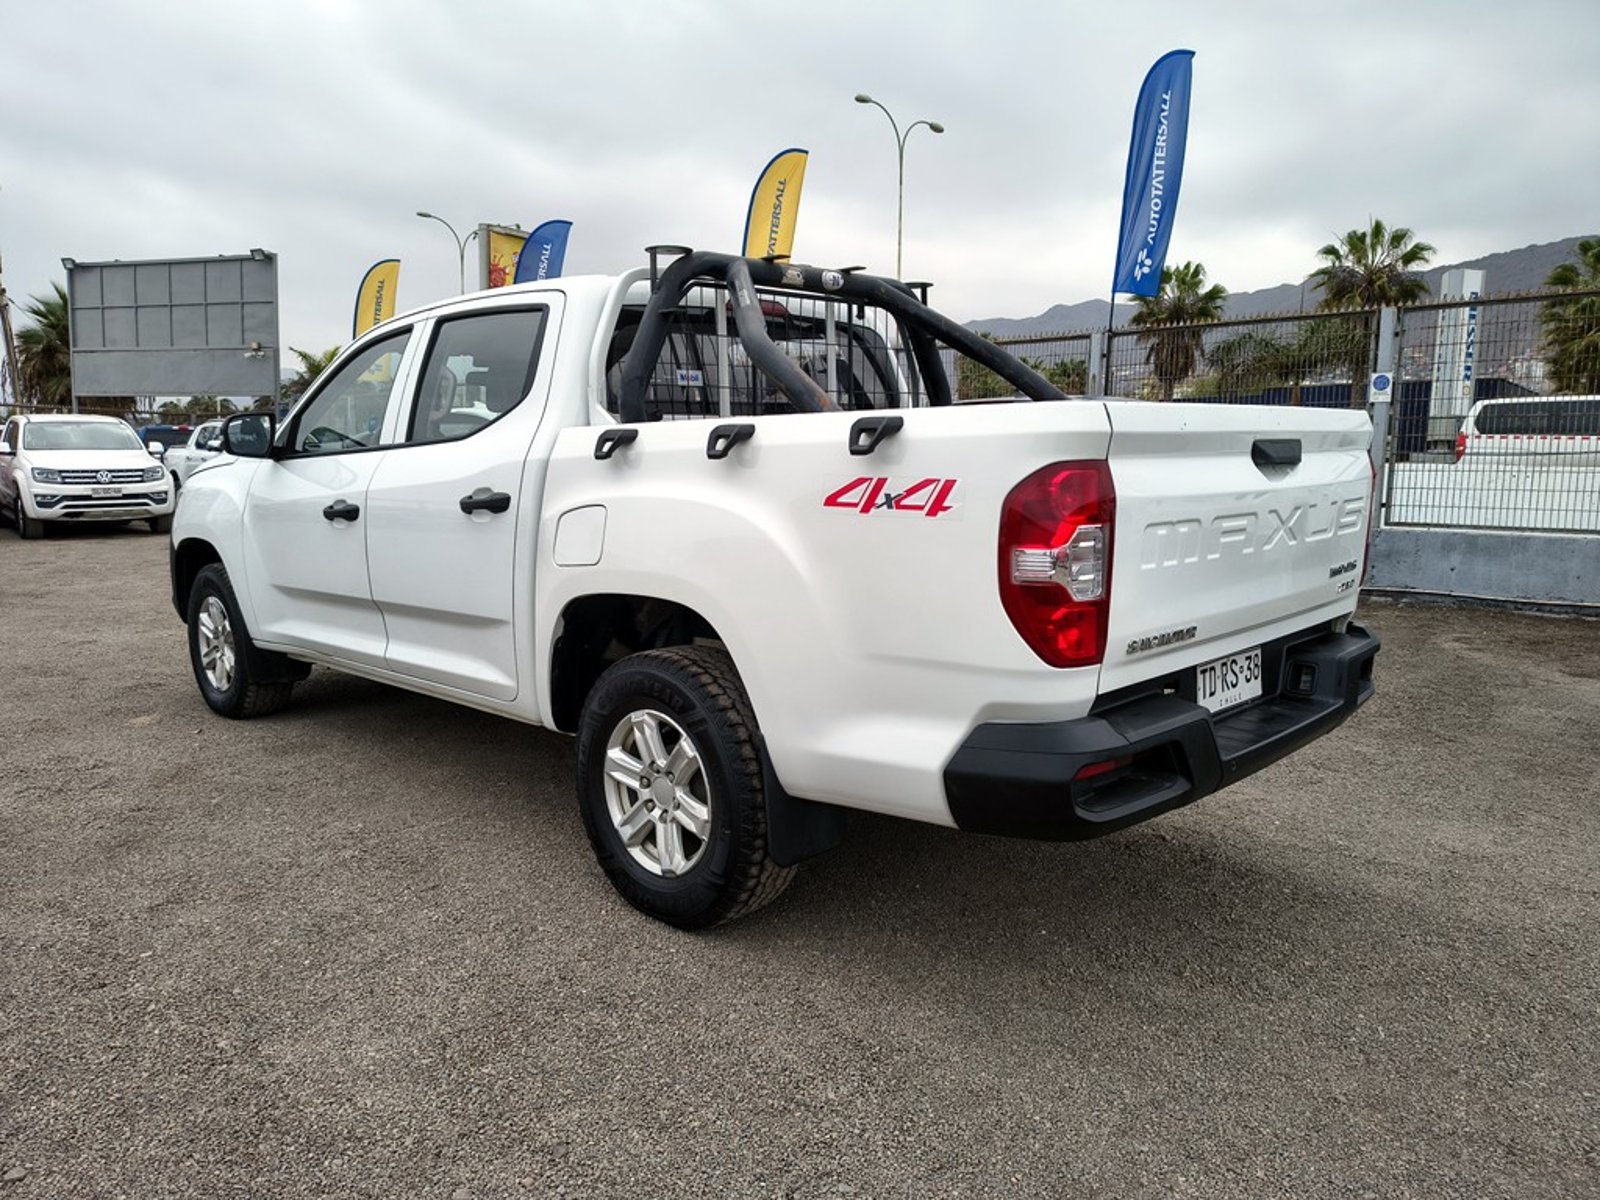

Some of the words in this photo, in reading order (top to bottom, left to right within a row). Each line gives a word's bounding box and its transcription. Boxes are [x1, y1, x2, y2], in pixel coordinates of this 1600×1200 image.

[1147, 90, 1171, 244] AUTOTATTERSALL
[823, 477, 957, 517] 4x4
[1140, 496, 1365, 570] MAXUS
